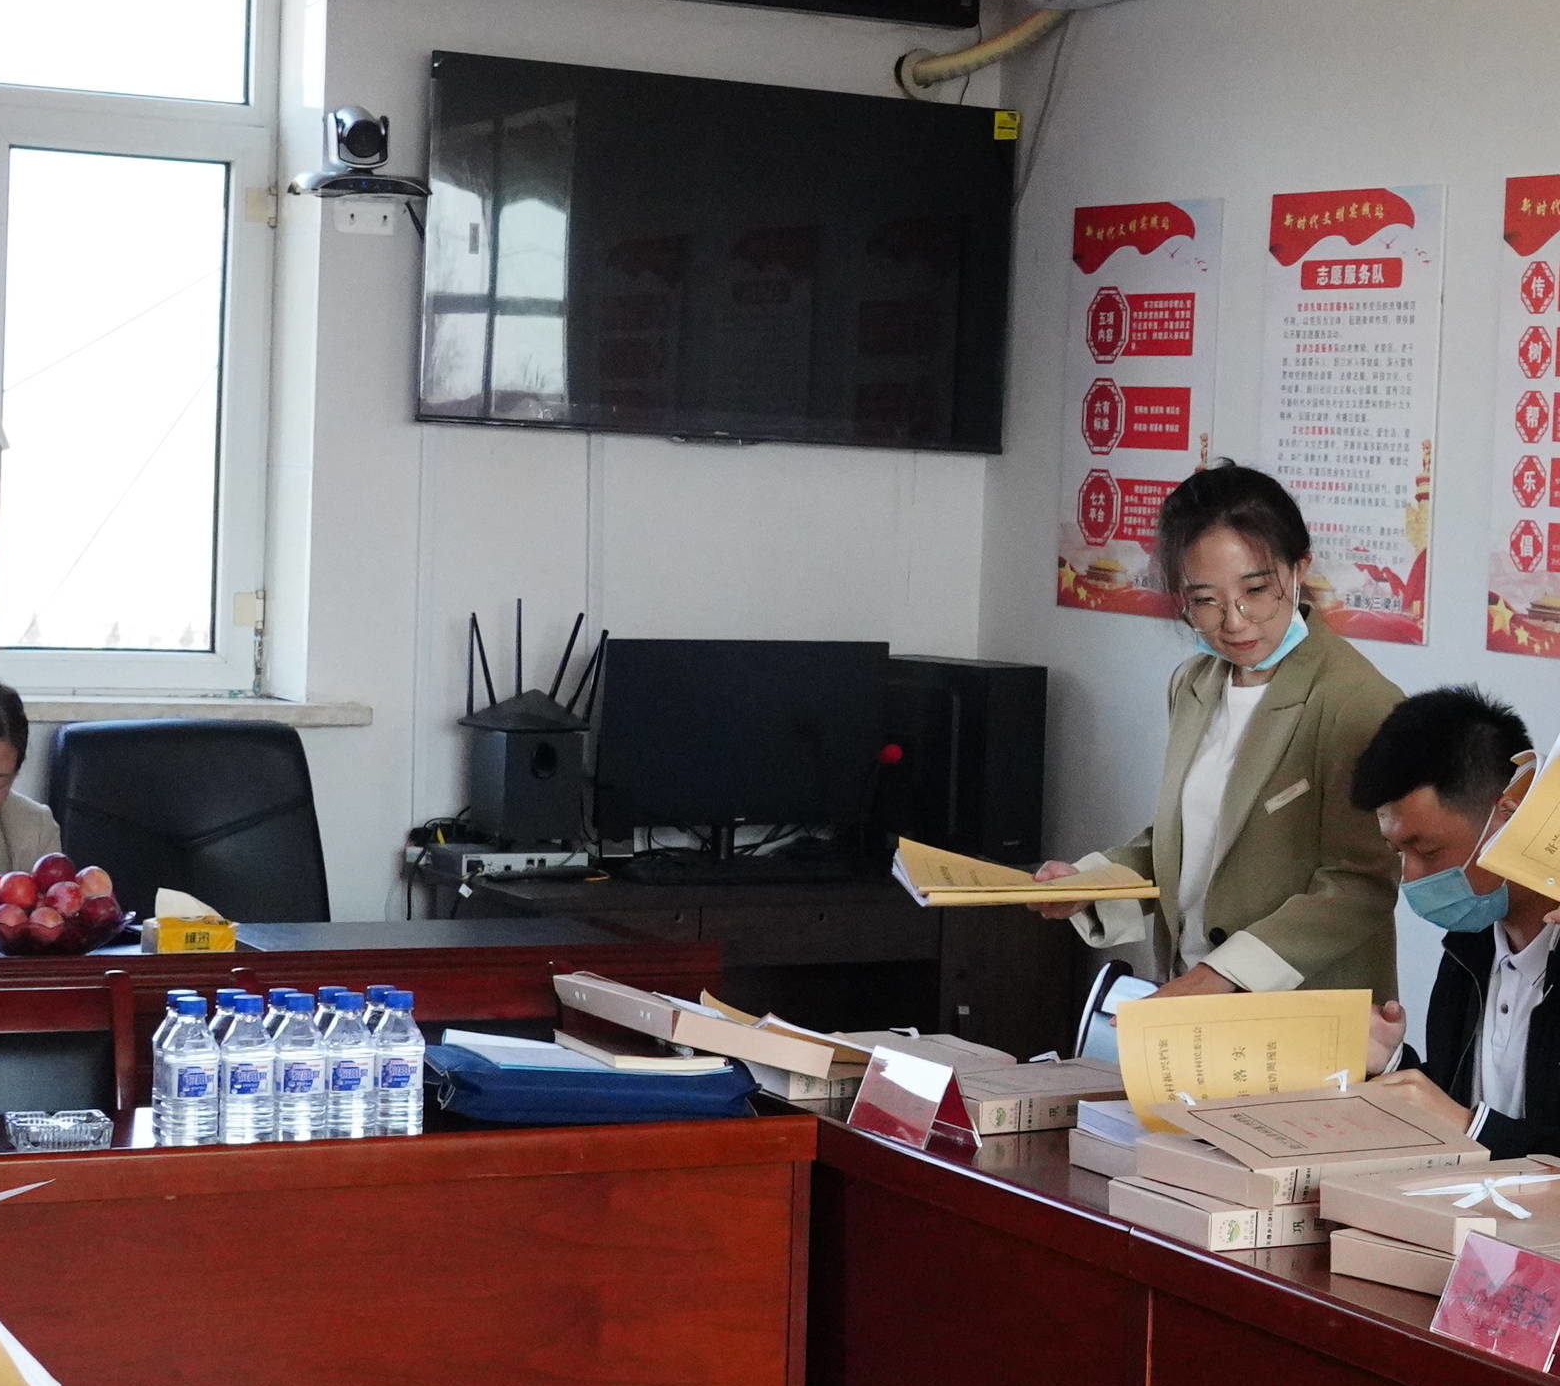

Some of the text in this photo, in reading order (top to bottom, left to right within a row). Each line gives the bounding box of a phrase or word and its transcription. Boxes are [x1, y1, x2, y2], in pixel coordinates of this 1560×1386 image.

[1316, 265, 1384, 286] 志愿服务队
[1531, 276, 1545, 299] 传
[1097, 312, 1114, 325] 五项
[1097, 330, 1114, 342] 内容
[1528, 341, 1543, 364] 树
[1094, 401, 1111, 414] 六有
[1525, 407, 1540, 428] 帮
[1093, 418, 1110, 432] 标准
[1522, 471, 1536, 493] 乐
[1090, 492, 1105, 505] 七大
[1089, 509, 1105, 522] 平台
